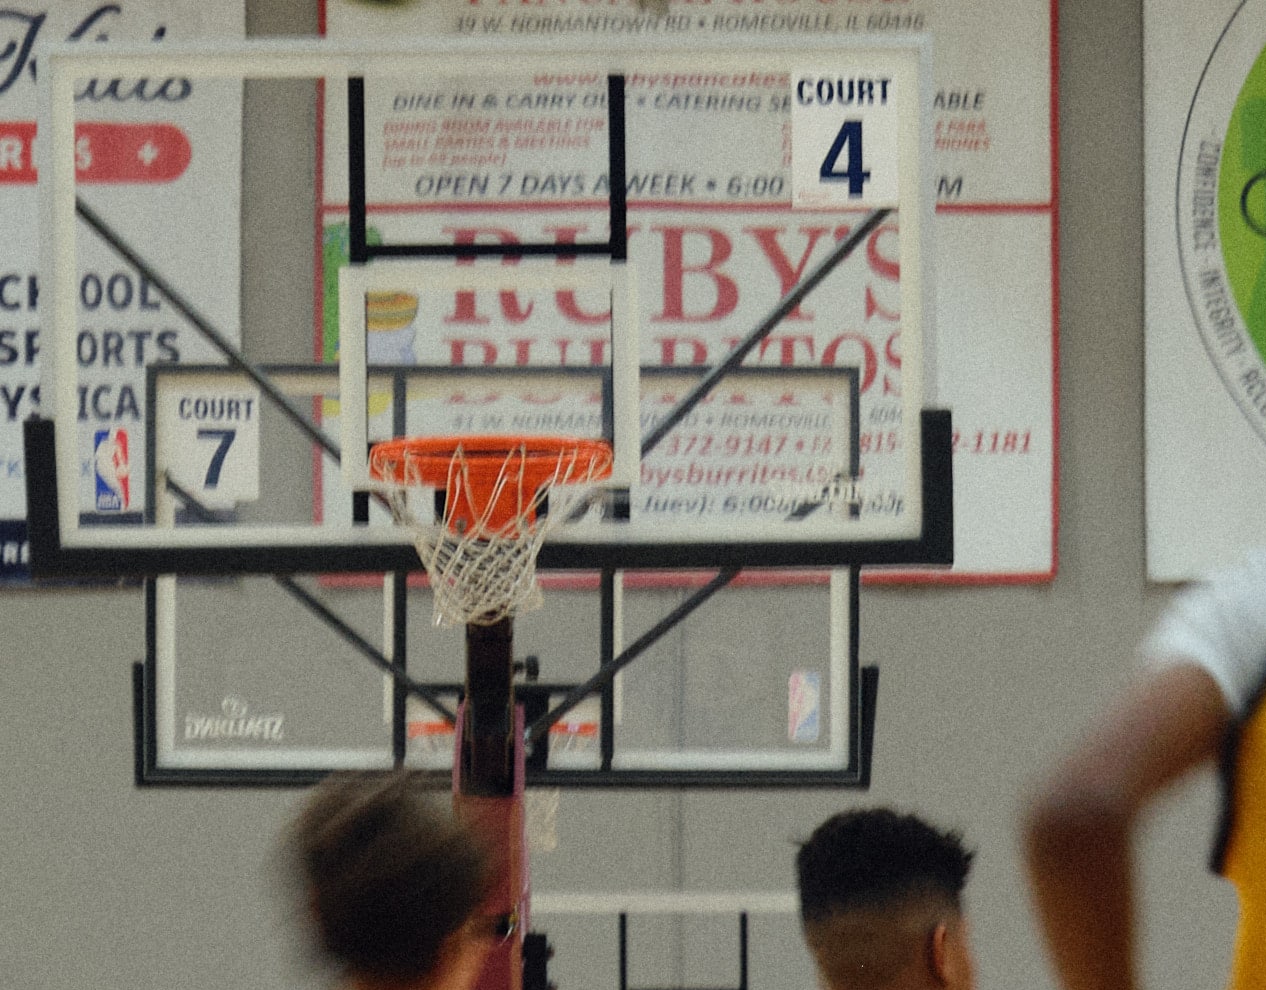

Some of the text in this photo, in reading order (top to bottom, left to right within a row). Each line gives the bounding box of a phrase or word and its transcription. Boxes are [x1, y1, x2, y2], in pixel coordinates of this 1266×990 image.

[797, 78, 892, 106] COURT
[819, 117, 871, 199] 4
[414, 173, 490, 196] OPEN
[499, 173, 513, 196] 7
[520, 173, 585, 196] DAYS
[625, 173, 695, 197] WEEK
[178, 396, 255, 421] COURT
[197, 427, 237, 489] 7
